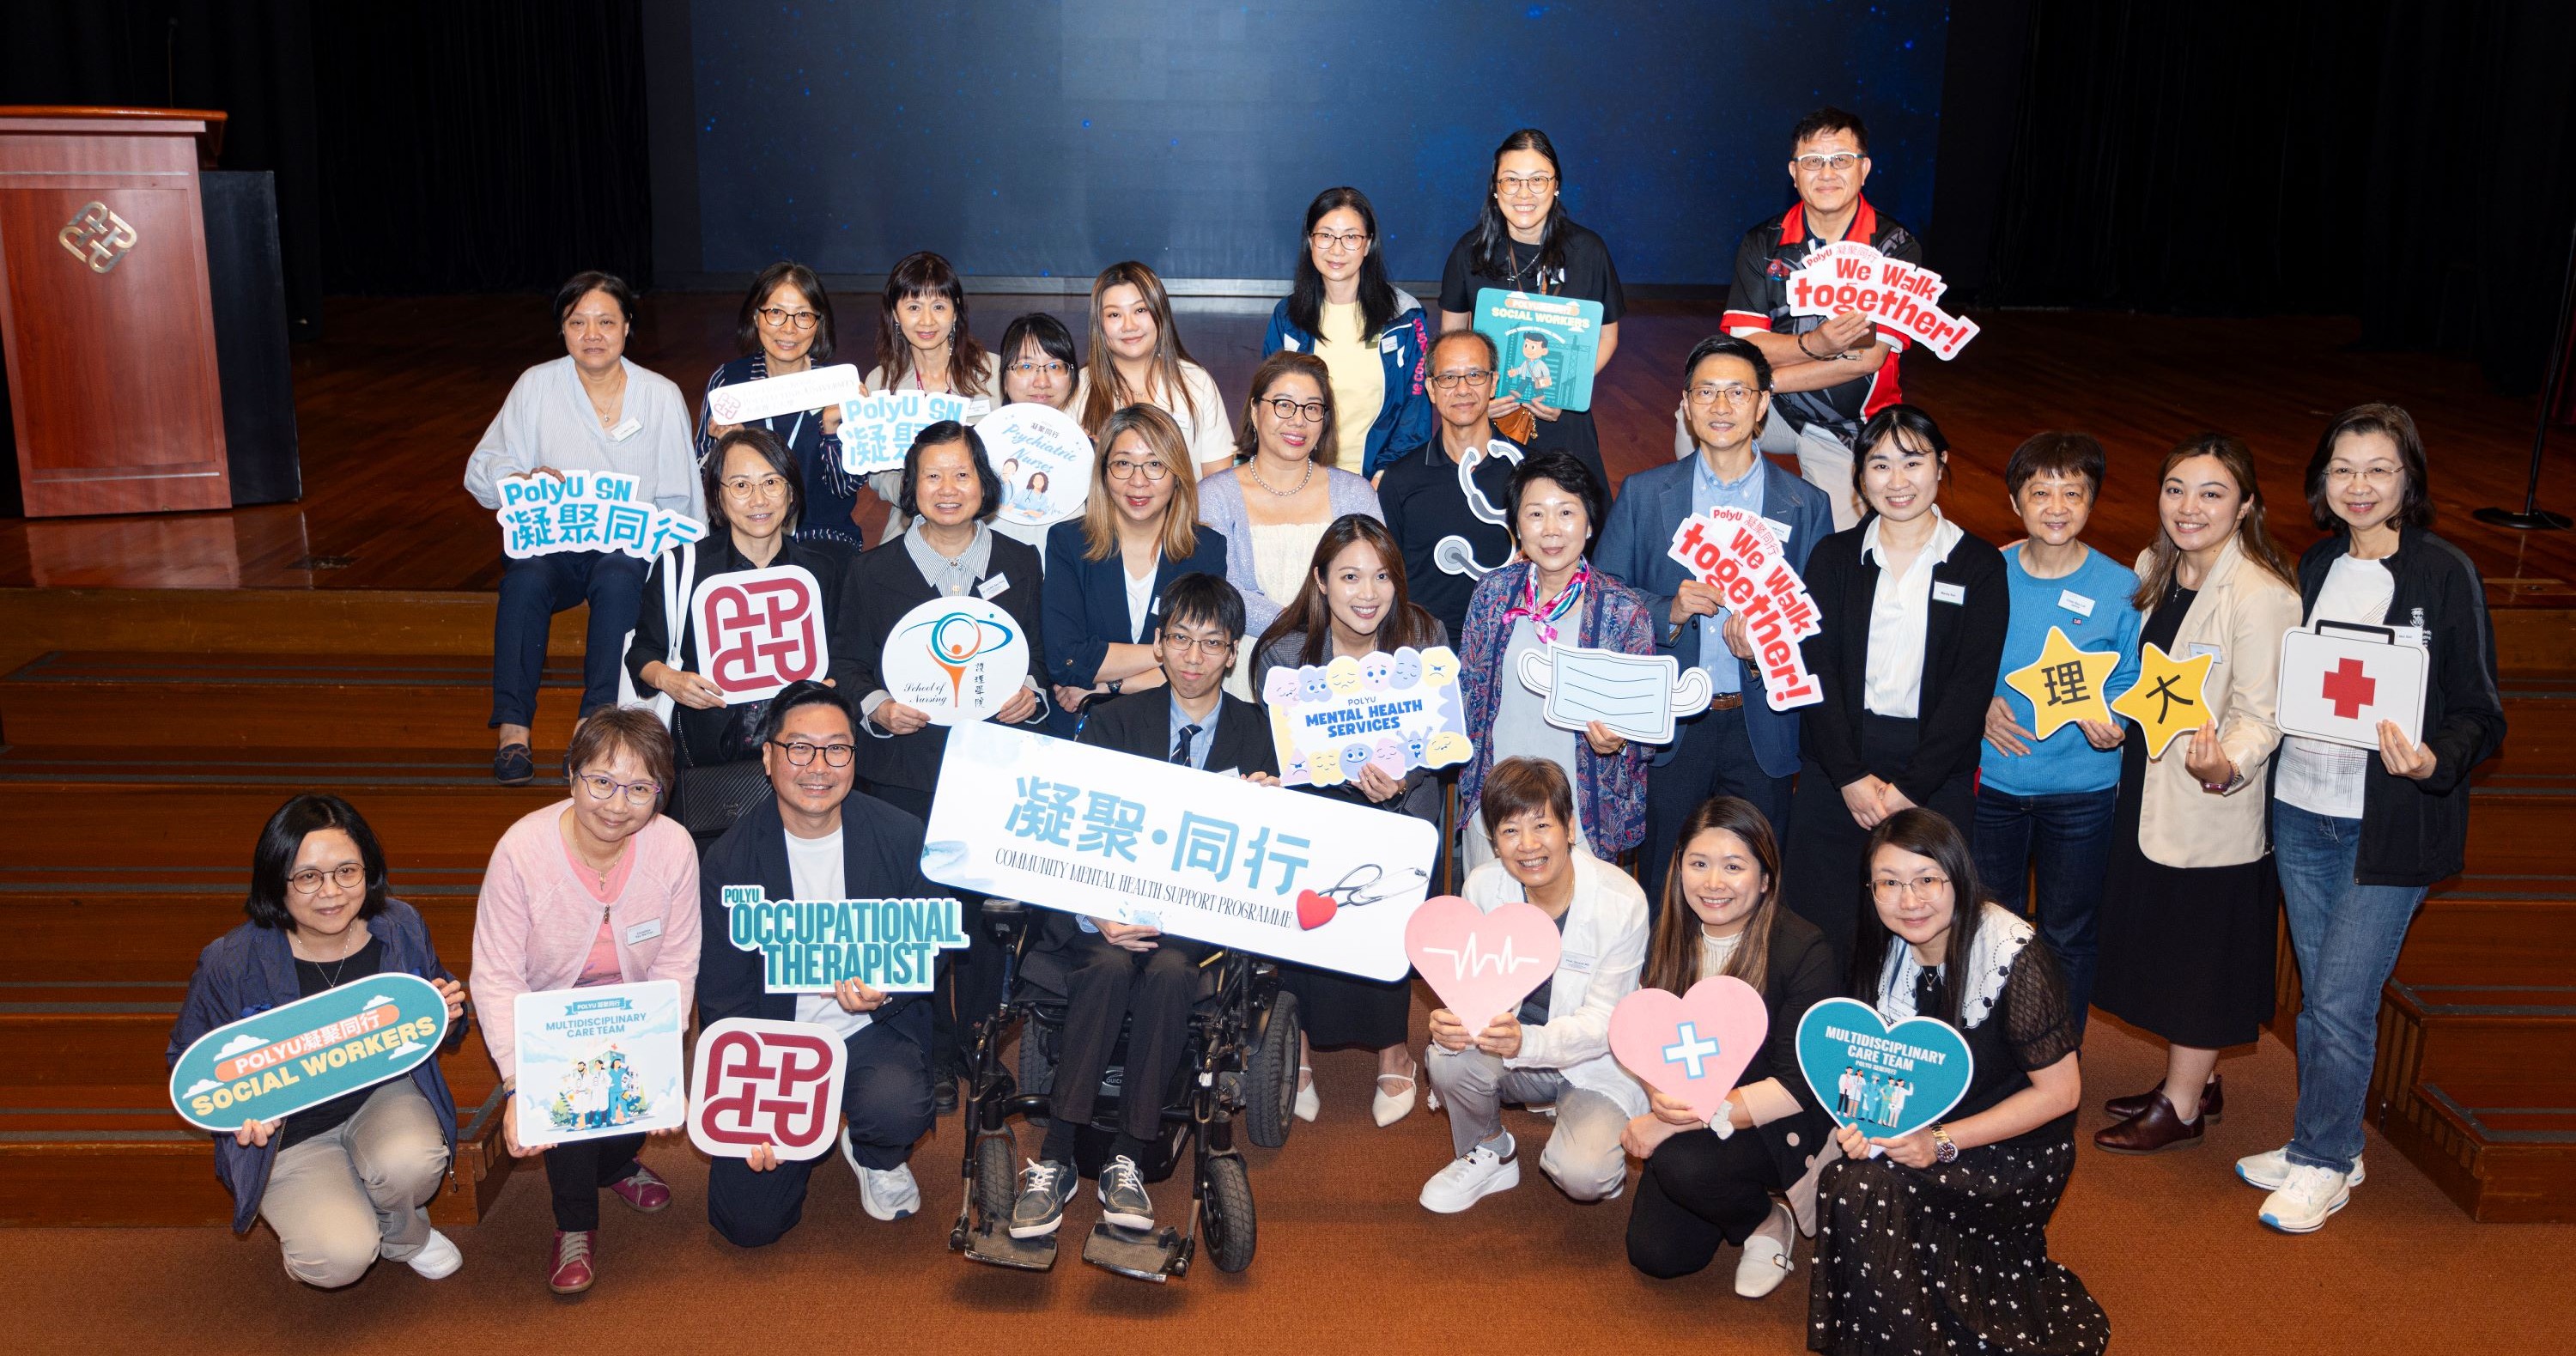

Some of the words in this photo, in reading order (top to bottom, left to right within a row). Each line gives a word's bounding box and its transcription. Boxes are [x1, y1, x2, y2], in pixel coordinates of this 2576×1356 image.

[1807, 248, 1832, 267] PolyU
[1836, 258, 1871, 281] We
[1881, 264, 1938, 301] Walk
[1492, 307, 1533, 321] SOCIAL
[1535, 313, 1590, 329] WORKERS
[1794, 277, 1969, 353] together!
[845, 396, 918, 423] PolyU
[929, 398, 963, 423] SN
[1002, 424, 1077, 462] Psychiatric
[1030, 423, 1060, 439] 凝聚同行
[1010, 447, 1054, 473] Nurses
[504, 477, 584, 506] PolyU
[595, 477, 632, 502] SN
[506, 503, 697, 555] 凝聚同行
[1713, 509, 1742, 521] PolyU
[1743, 514, 1779, 556] 凝聚同行
[1729, 526, 1765, 569] We
[1764, 565, 1812, 635] Walk
[1679, 523, 1811, 702] together!
[904, 682, 934, 692] School
[936, 682, 946, 694] of
[2041, 660, 2091, 706] 理
[909, 695, 947, 706] Nursing
[1305, 708, 1363, 727] MENTAL
[1369, 699, 1423, 718] HEALTH
[1348, 696, 1376, 707] POLYU
[2146, 674, 2194, 724] 大
[1327, 716, 1400, 738] SERVICES
[724, 888, 760, 903] POLYU
[995, 848, 1069, 879] COMMUNITY
[1069, 864, 1115, 890] MENTAL
[1118, 874, 1163, 899] HEALTH
[1163, 885, 1218, 911] SUPPORT
[1218, 896, 1293, 928] PROGRAMME
[732, 902, 962, 946] OCCUPATIONAL
[762, 942, 931, 985] THERAPIST
[545, 1012, 647, 1031] MULTIDISCIPLINARY
[567, 1028, 594, 1037] CARE
[597, 1025, 625, 1035] TEAM
[1826, 1025, 1946, 1065] MULTIDISCIPLINARY
[1847, 1046, 1880, 1063] CARE
[1882, 1053, 1914, 1072] TEAM
[191, 1066, 300, 1116] SOCIAL
[301, 1017, 436, 1078] WORKERS
